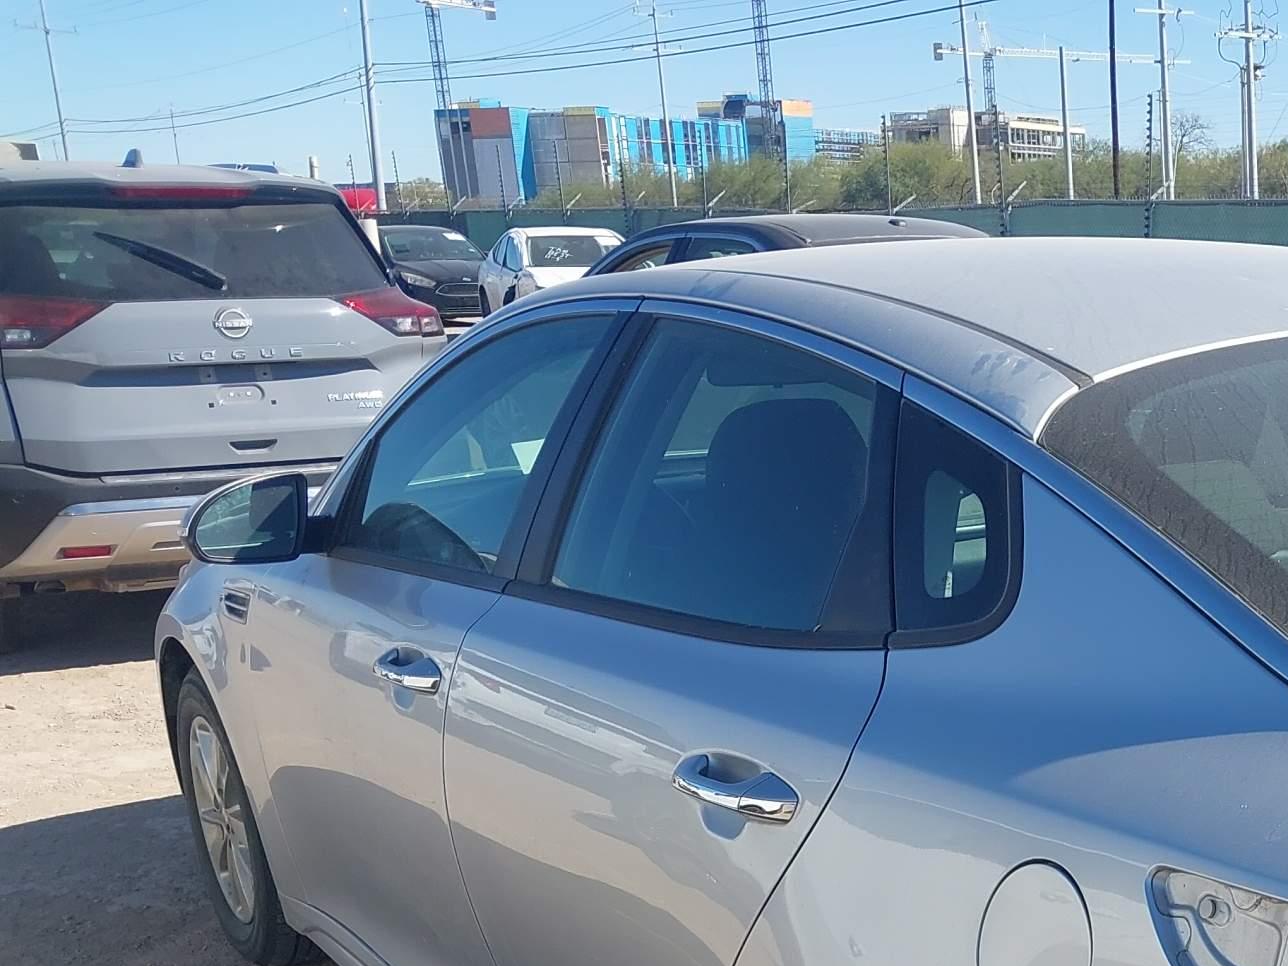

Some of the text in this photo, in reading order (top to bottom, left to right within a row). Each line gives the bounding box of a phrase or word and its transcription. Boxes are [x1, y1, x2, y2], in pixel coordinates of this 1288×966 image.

[214, 318, 253, 328] NISSAN
[168, 347, 303, 363] ROGUE
[359, 400, 382, 409] AWD
